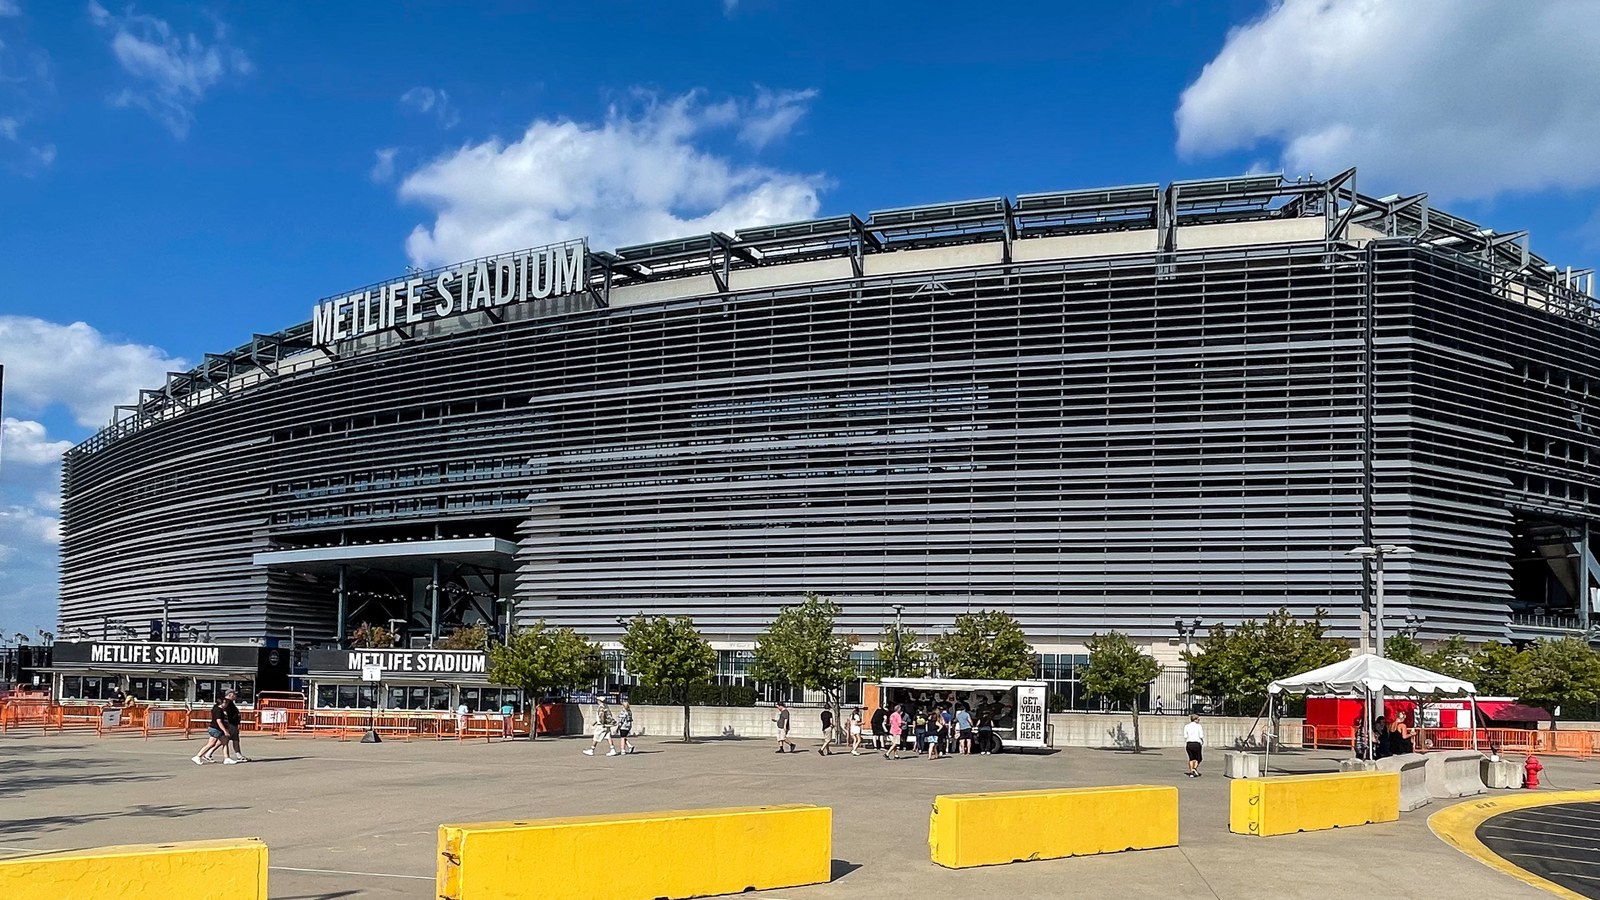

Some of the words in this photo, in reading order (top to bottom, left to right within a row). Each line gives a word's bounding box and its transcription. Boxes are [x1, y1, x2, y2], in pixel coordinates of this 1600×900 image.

[312, 277, 425, 346] METLIFE
[435, 244, 584, 318] STADIUM
[91, 644, 151, 663] METLIFE
[155, 646, 219, 665] STADIUM
[348, 652, 413, 671] METLIFE
[417, 653, 486, 672] STADIUM
[1023, 697, 1038, 705] GET
[1020, 714, 1042, 722] TEAM
[1021, 722, 1041, 730] GEAR
[1020, 731, 1041, 739] HERE
